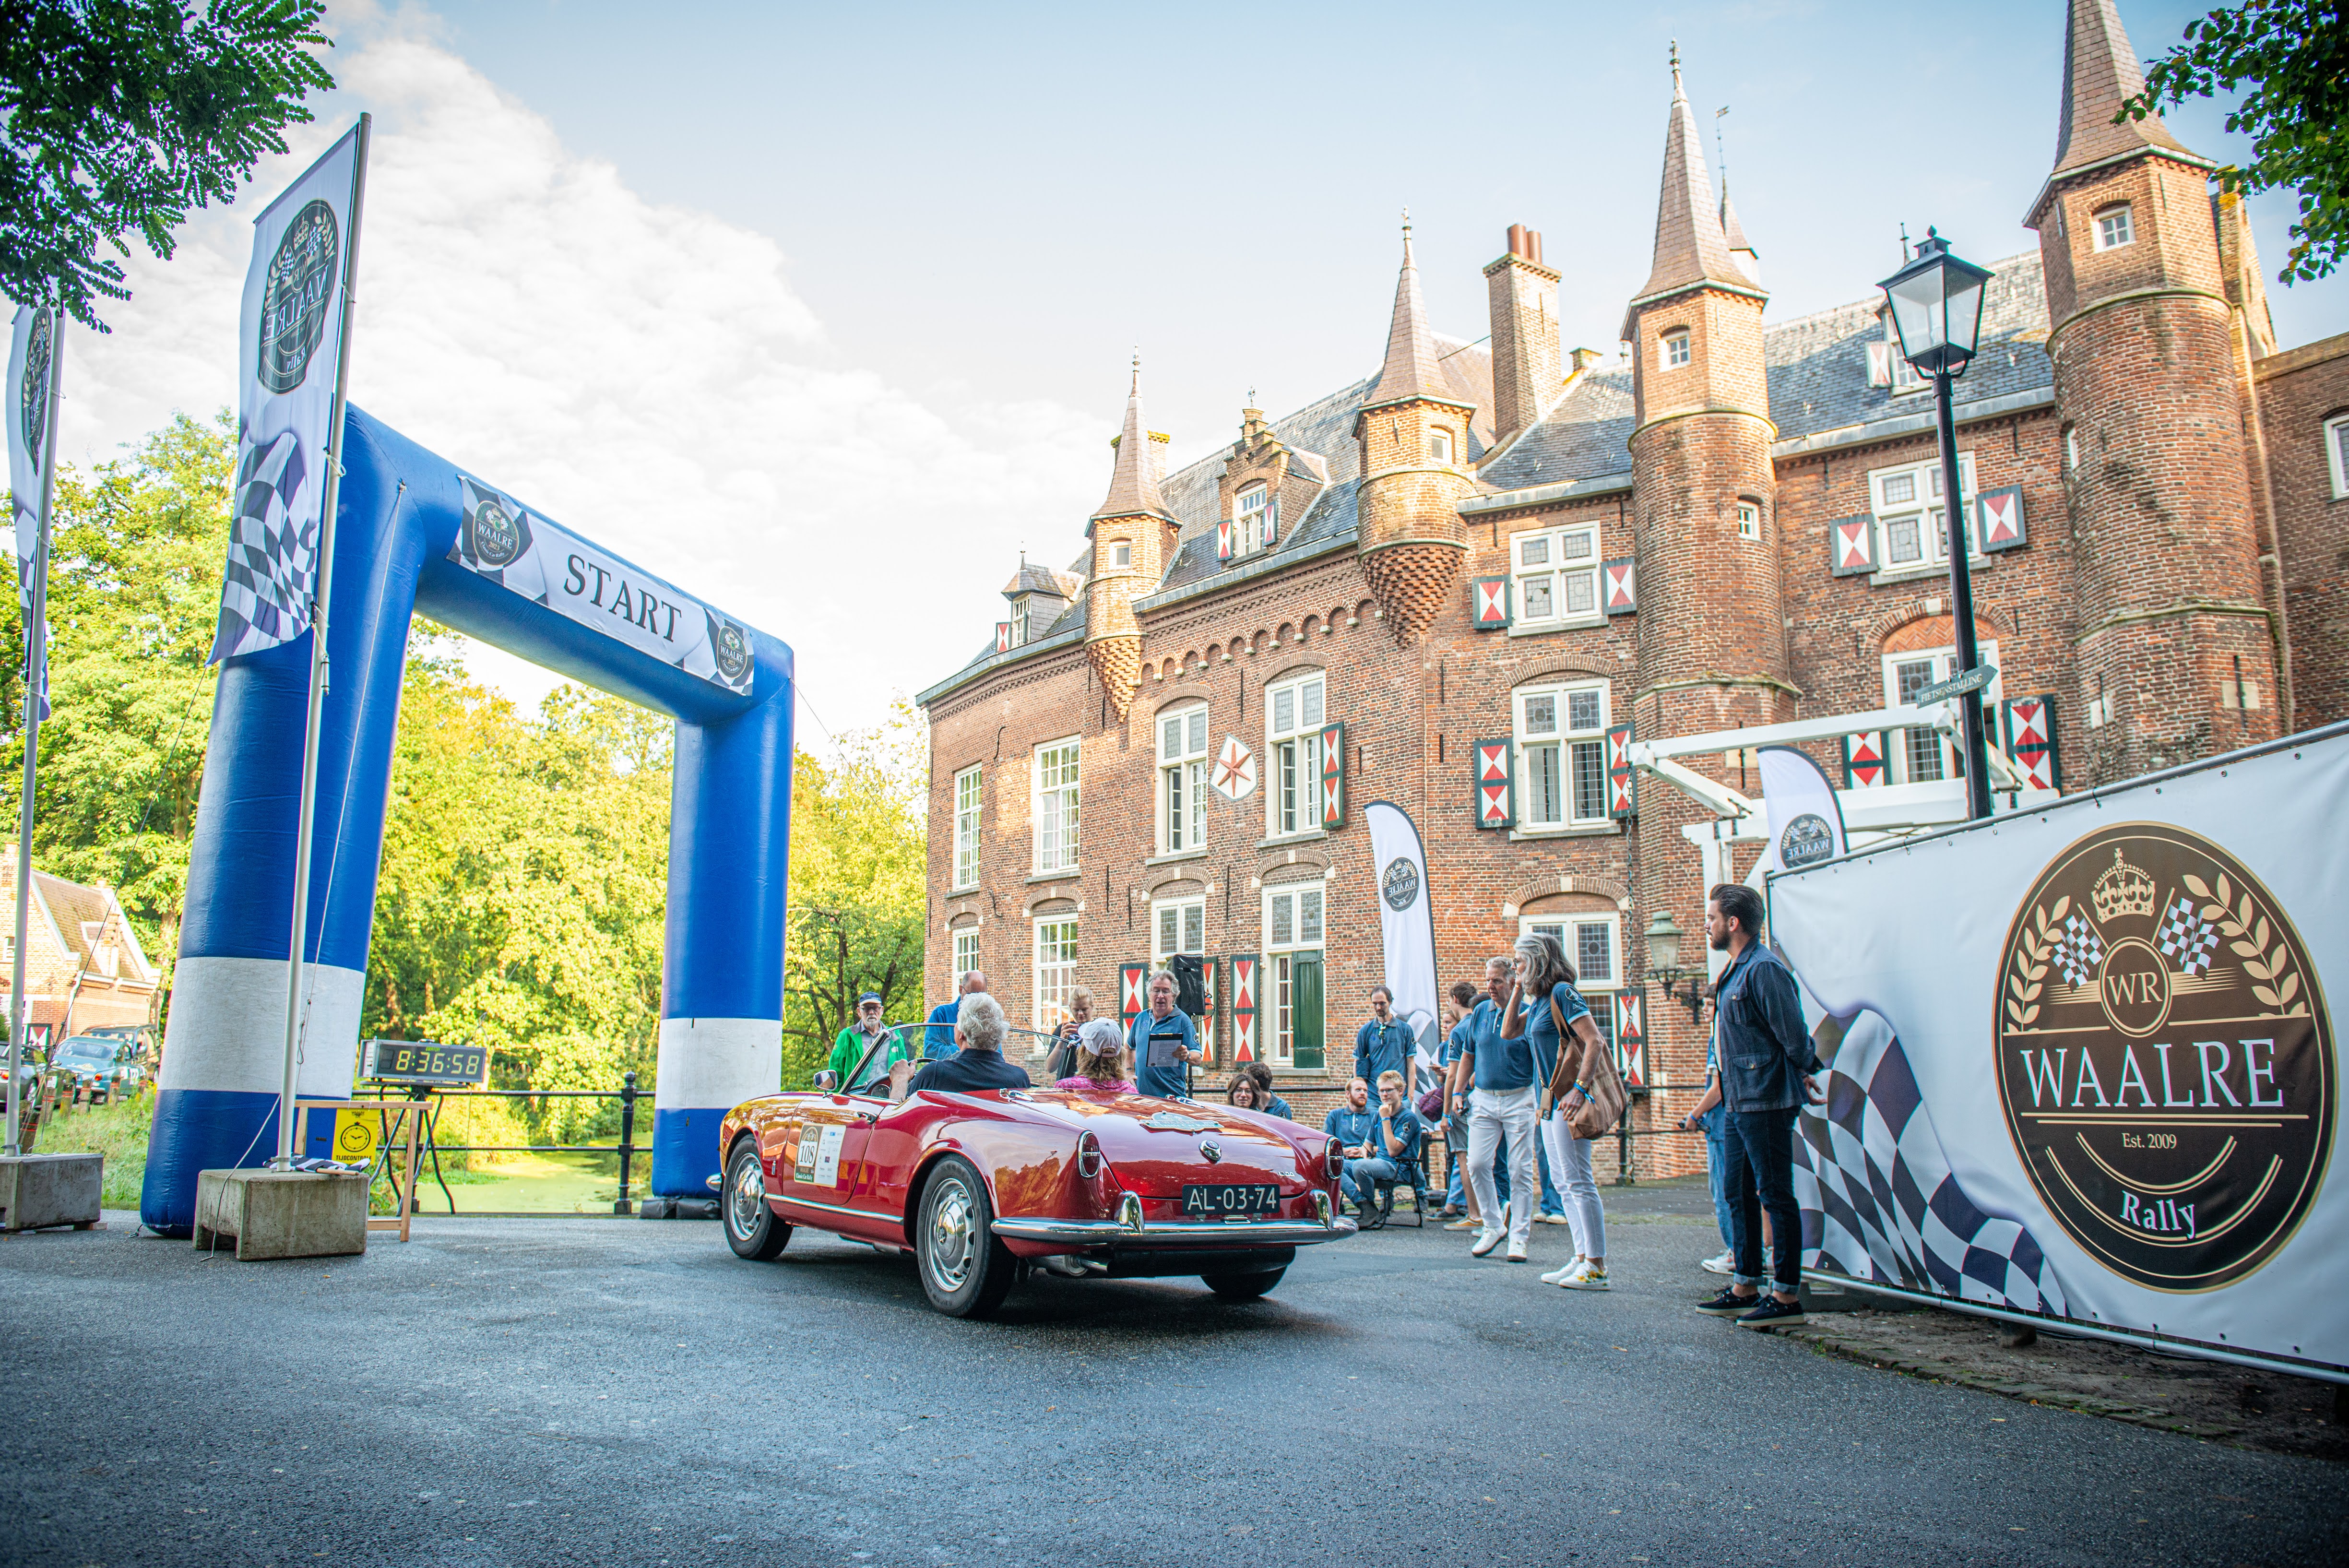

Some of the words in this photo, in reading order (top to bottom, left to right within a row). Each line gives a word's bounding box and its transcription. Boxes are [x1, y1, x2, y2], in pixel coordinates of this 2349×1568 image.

[478, 523, 513, 549] WAALRE
[488, 541, 500, 551] 2023
[564, 554, 682, 642] START
[721, 645, 744, 663] WAALRE
[1921, 673, 1982, 702] FIETSENSTALLING
[2106, 971, 2163, 1006] WR
[396, 1050, 480, 1075] 8:36:58
[2020, 1038, 2284, 1107] WAALRE
[2122, 1133, 2145, 1148] Est.
[2148, 1133, 2177, 1149] 2009
[800, 1145, 815, 1164] 108
[1187, 1187, 1277, 1211] AL-03-74
[2120, 1190, 2195, 1239] Rally
